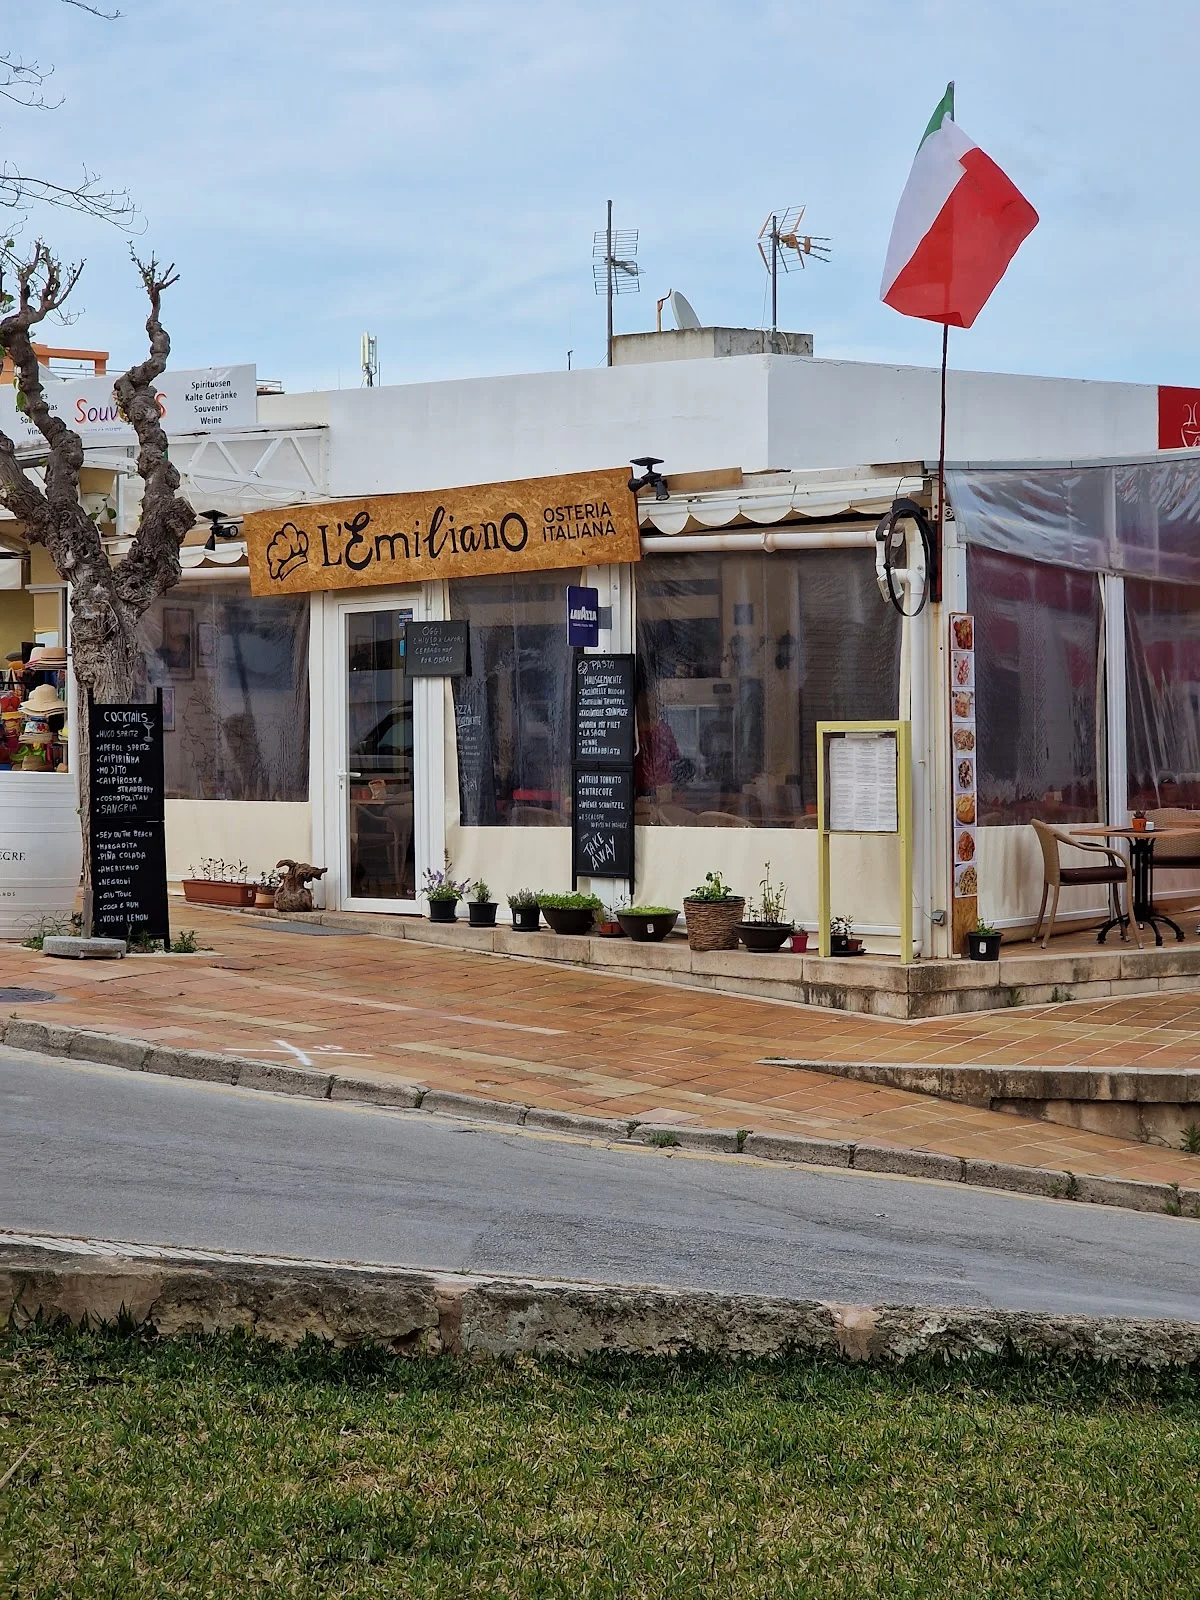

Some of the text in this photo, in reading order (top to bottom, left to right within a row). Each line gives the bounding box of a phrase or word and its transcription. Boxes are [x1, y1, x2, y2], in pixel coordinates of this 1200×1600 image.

[192, 380, 231, 390] Spirituosen
[185, 391, 238, 401] Kalte Getränke
[194, 403, 228, 413] Souvenirs
[200, 416, 222, 424] Weine
[542, 501, 612, 523] OSTERIA
[542, 521, 616, 542] ITALIANA
[570, 606, 597, 621] LAVAZZA
[589, 660, 615, 670] PASTA
[104, 710, 148, 722] COCKTAILS
[99, 730, 114, 738] HUGO
[127, 743, 150, 751] SPRITZ
[99, 776, 142, 784] CAIPIROSKA
[582, 787, 612, 796] ENTRECOTE
[101, 804, 137, 814] SANGRIA
[598, 801, 625, 809] SCHNITZEL
[583, 832, 604, 856] TAKE
[100, 850, 116, 860] PIÑA
[591, 835, 616, 871] AWAY
[100, 864, 139, 873] AMERICANO
[101, 877, 130, 886] NEGRONI
[103, 914, 148, 922] VODKA LEMON
